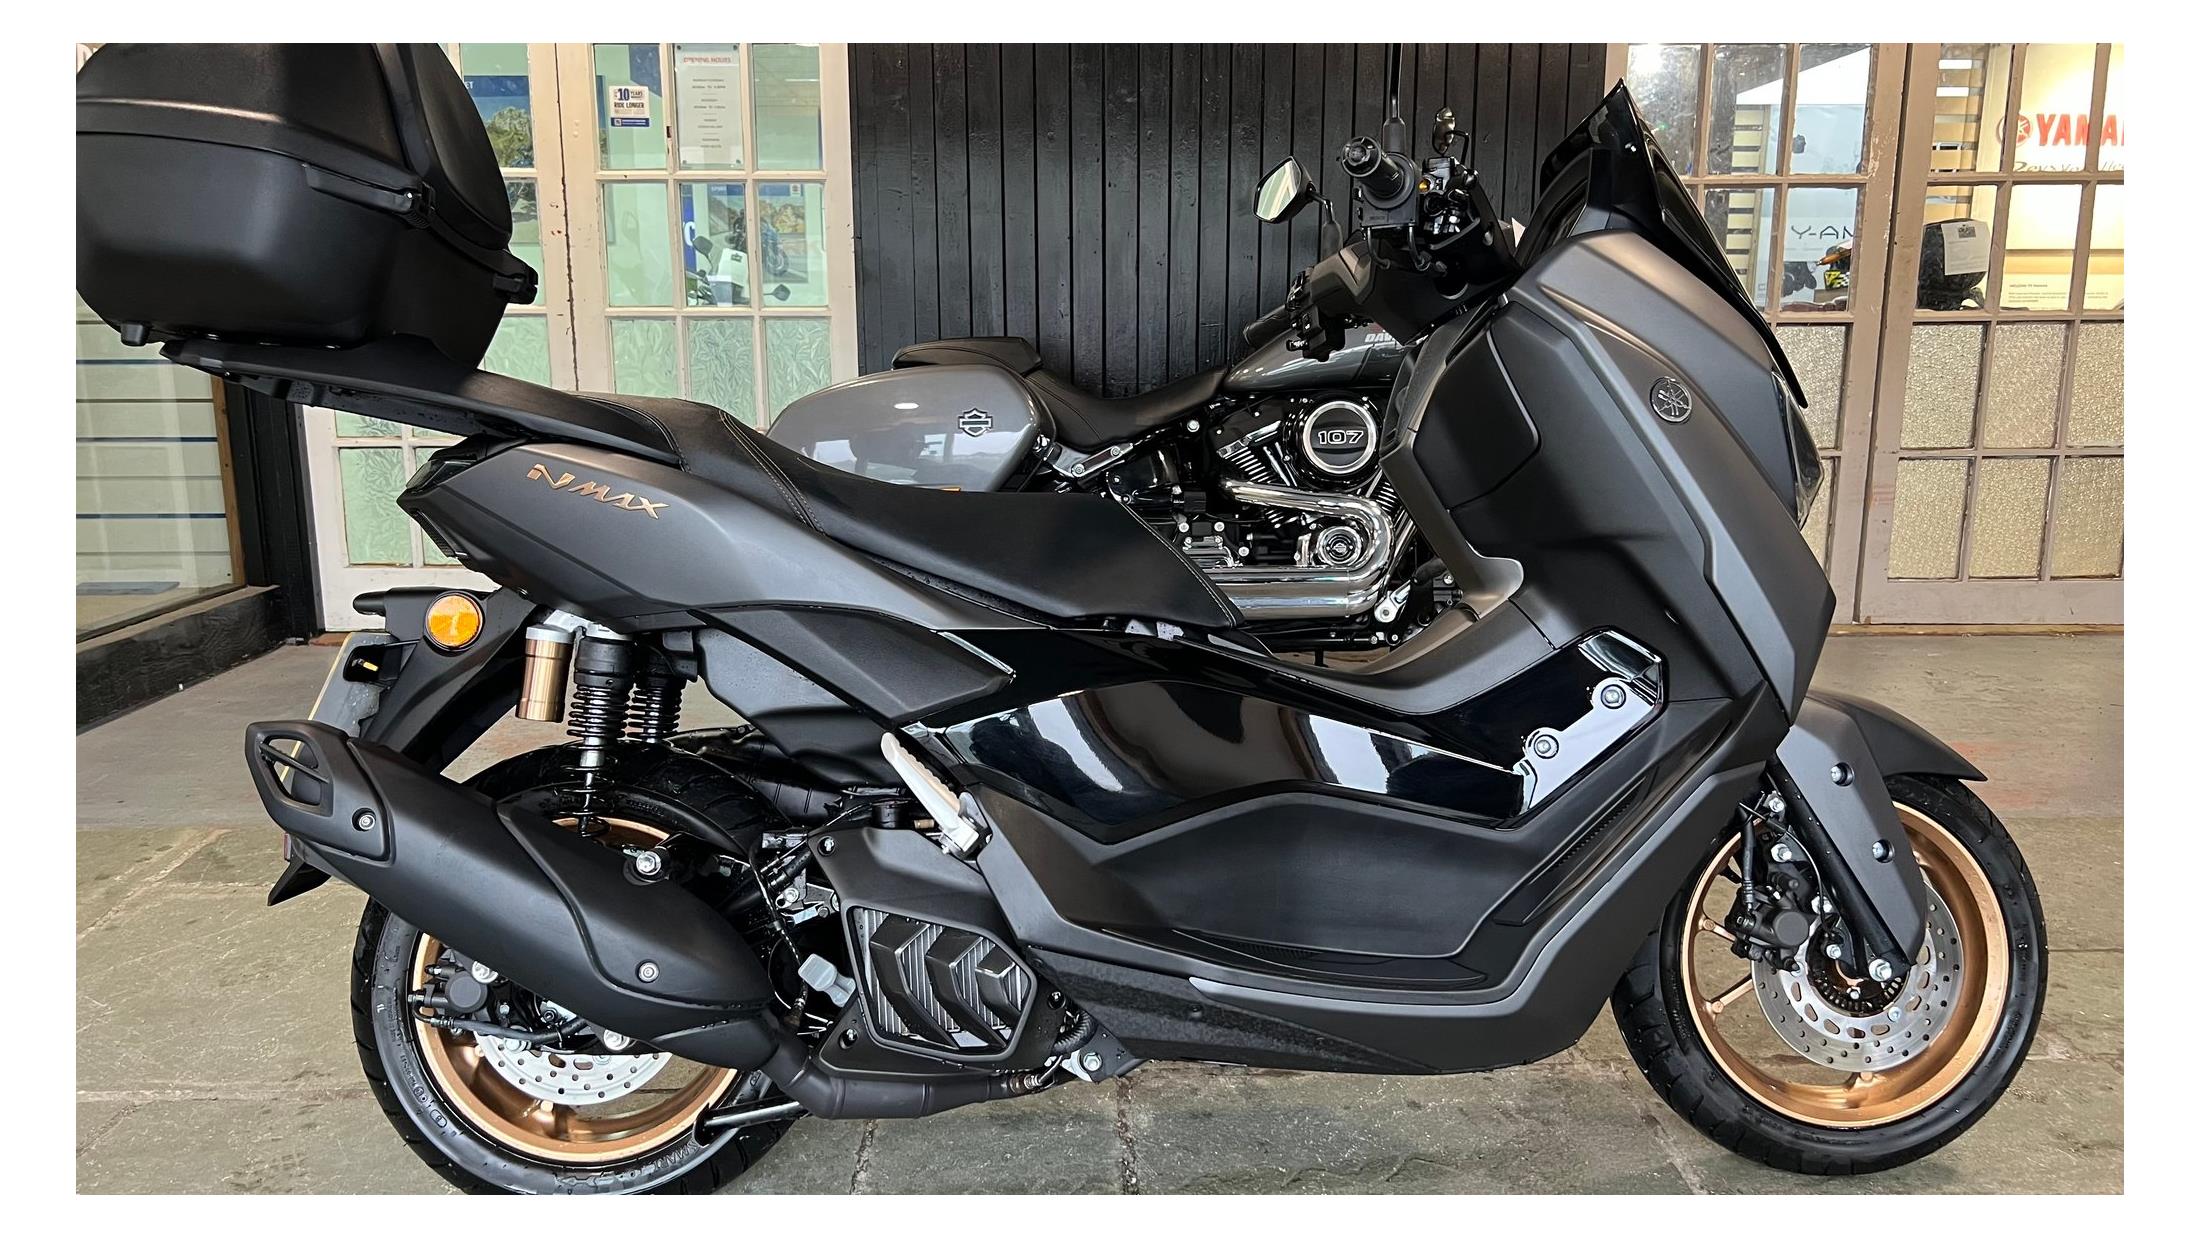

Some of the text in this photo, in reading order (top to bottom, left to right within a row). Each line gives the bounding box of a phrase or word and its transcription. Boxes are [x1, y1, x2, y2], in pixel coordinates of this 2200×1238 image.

[618, 88, 630, 101] 10
[2036, 114, 2124, 146] YAMA
[1365, 332, 1394, 342] DAV
[1318, 430, 1364, 445] 107
[527, 463, 670, 520] NMAX
